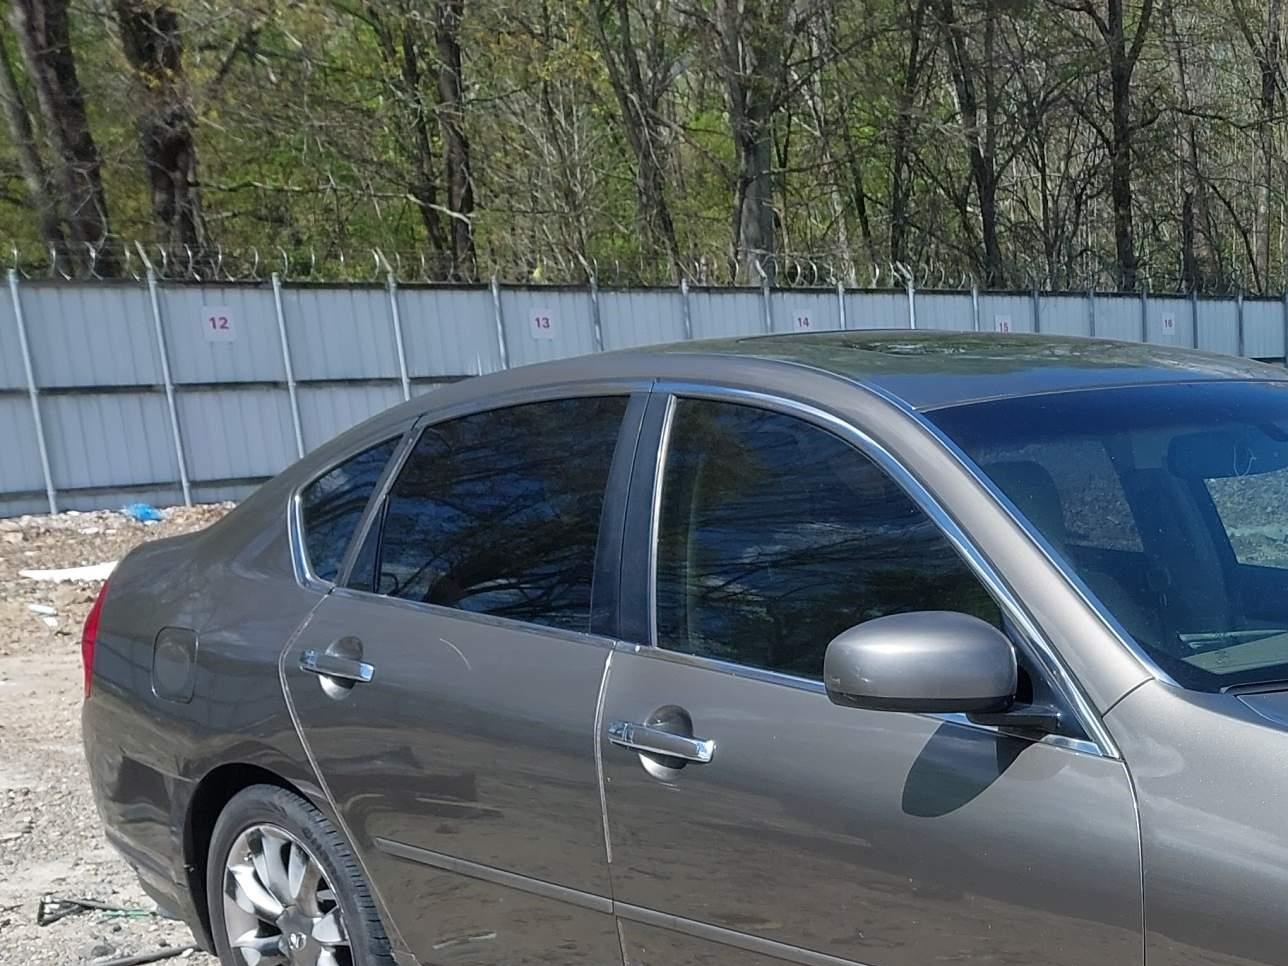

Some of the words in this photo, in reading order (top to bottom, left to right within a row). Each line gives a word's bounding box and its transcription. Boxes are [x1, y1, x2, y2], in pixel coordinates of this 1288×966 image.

[209, 316, 229, 330] 12
[535, 316, 550, 329] 13
[797, 316, 809, 328] 14
